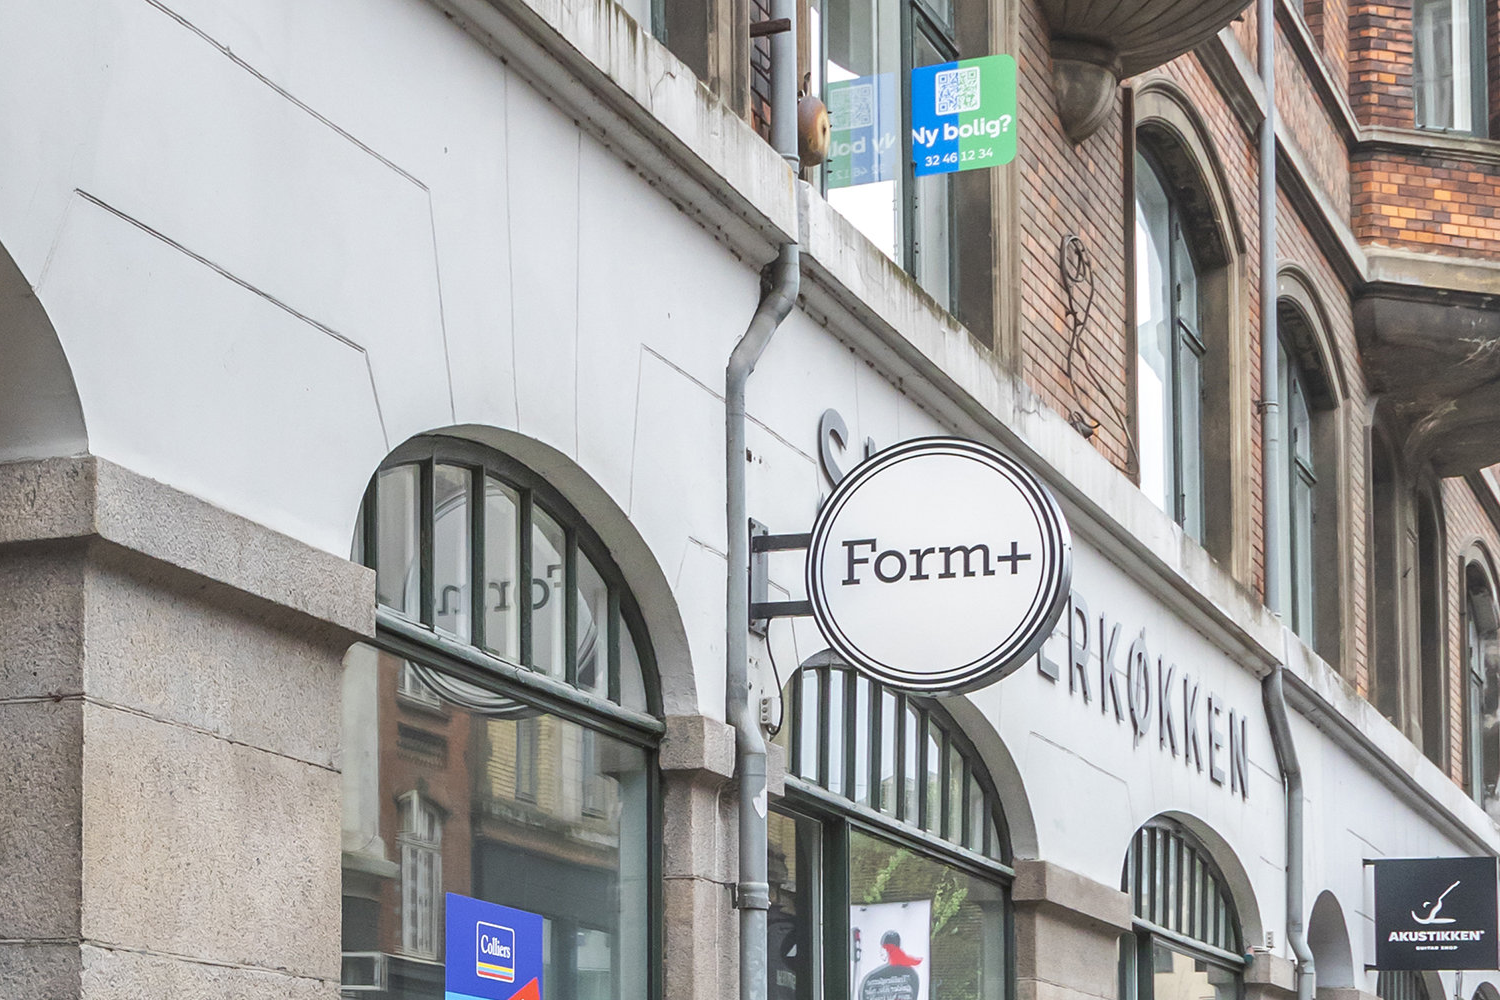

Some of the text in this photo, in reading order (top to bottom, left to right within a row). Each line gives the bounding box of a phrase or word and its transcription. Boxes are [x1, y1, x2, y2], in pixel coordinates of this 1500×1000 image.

[912, 114, 1012, 148] Ny bolig?
[925, 147, 994, 167] 32 46 12 34
[841, 537, 1032, 586] Form+
[480, 934, 511, 959] Colliers
[1388, 931, 1481, 942] AKUSTIKKEN
